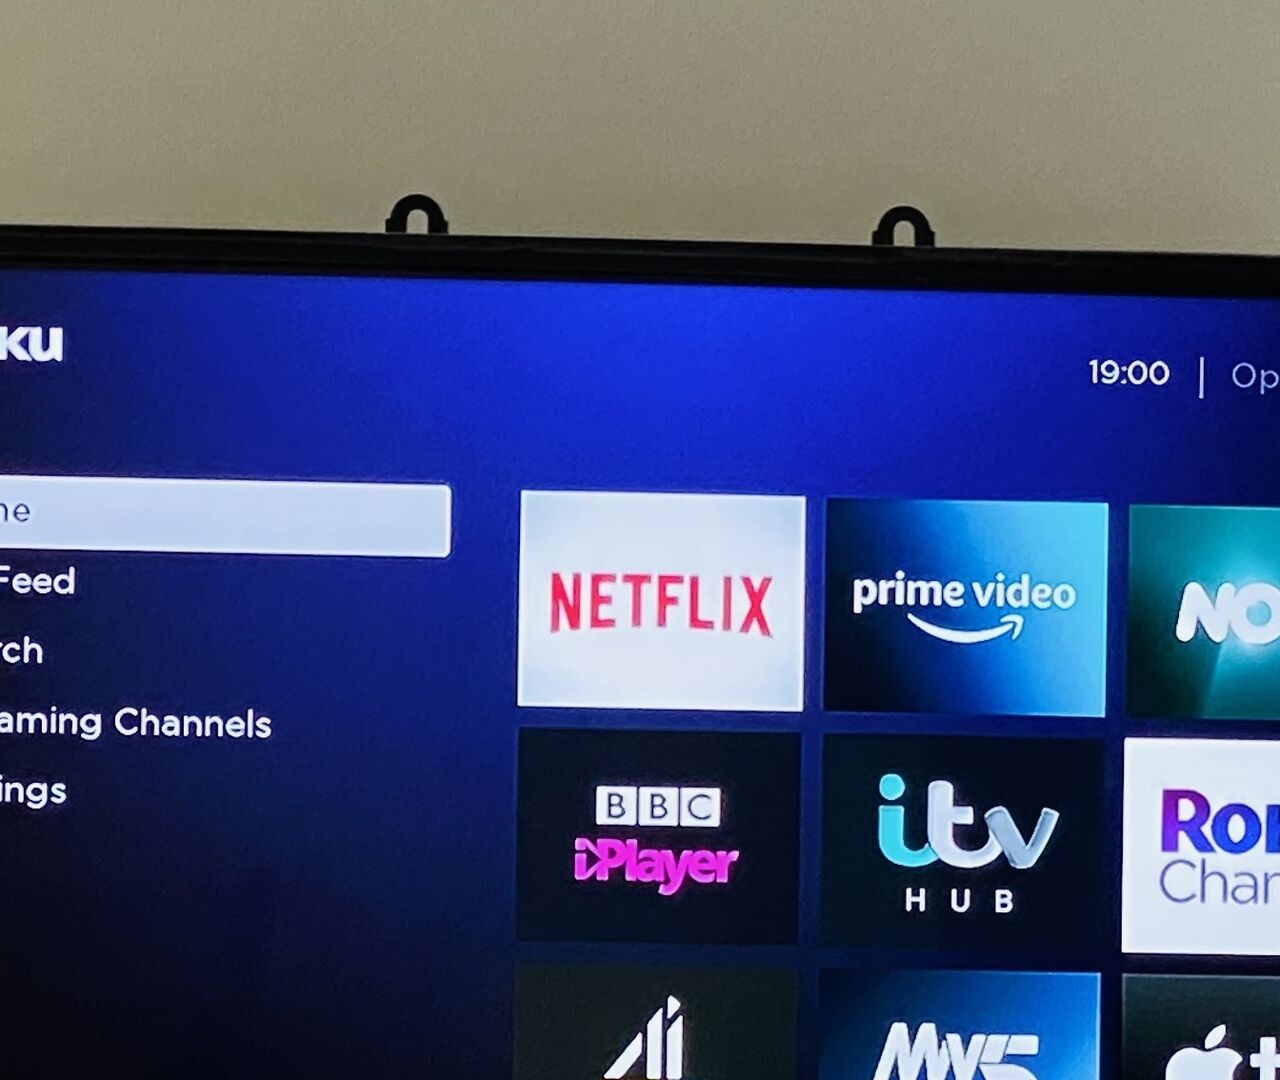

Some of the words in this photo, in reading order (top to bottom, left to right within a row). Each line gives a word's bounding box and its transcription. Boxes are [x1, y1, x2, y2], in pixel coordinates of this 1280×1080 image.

[1088, 358, 1171, 387] 19:00
[549, 572, 773, 638] NETFLIX
[853, 570, 965, 614] prime
[972, 572, 1077, 610] video
[114, 708, 272, 739] Channels
[603, 791, 717, 822] BBC
[878, 773, 1061, 869] itv
[575, 838, 739, 895] iPlayer
